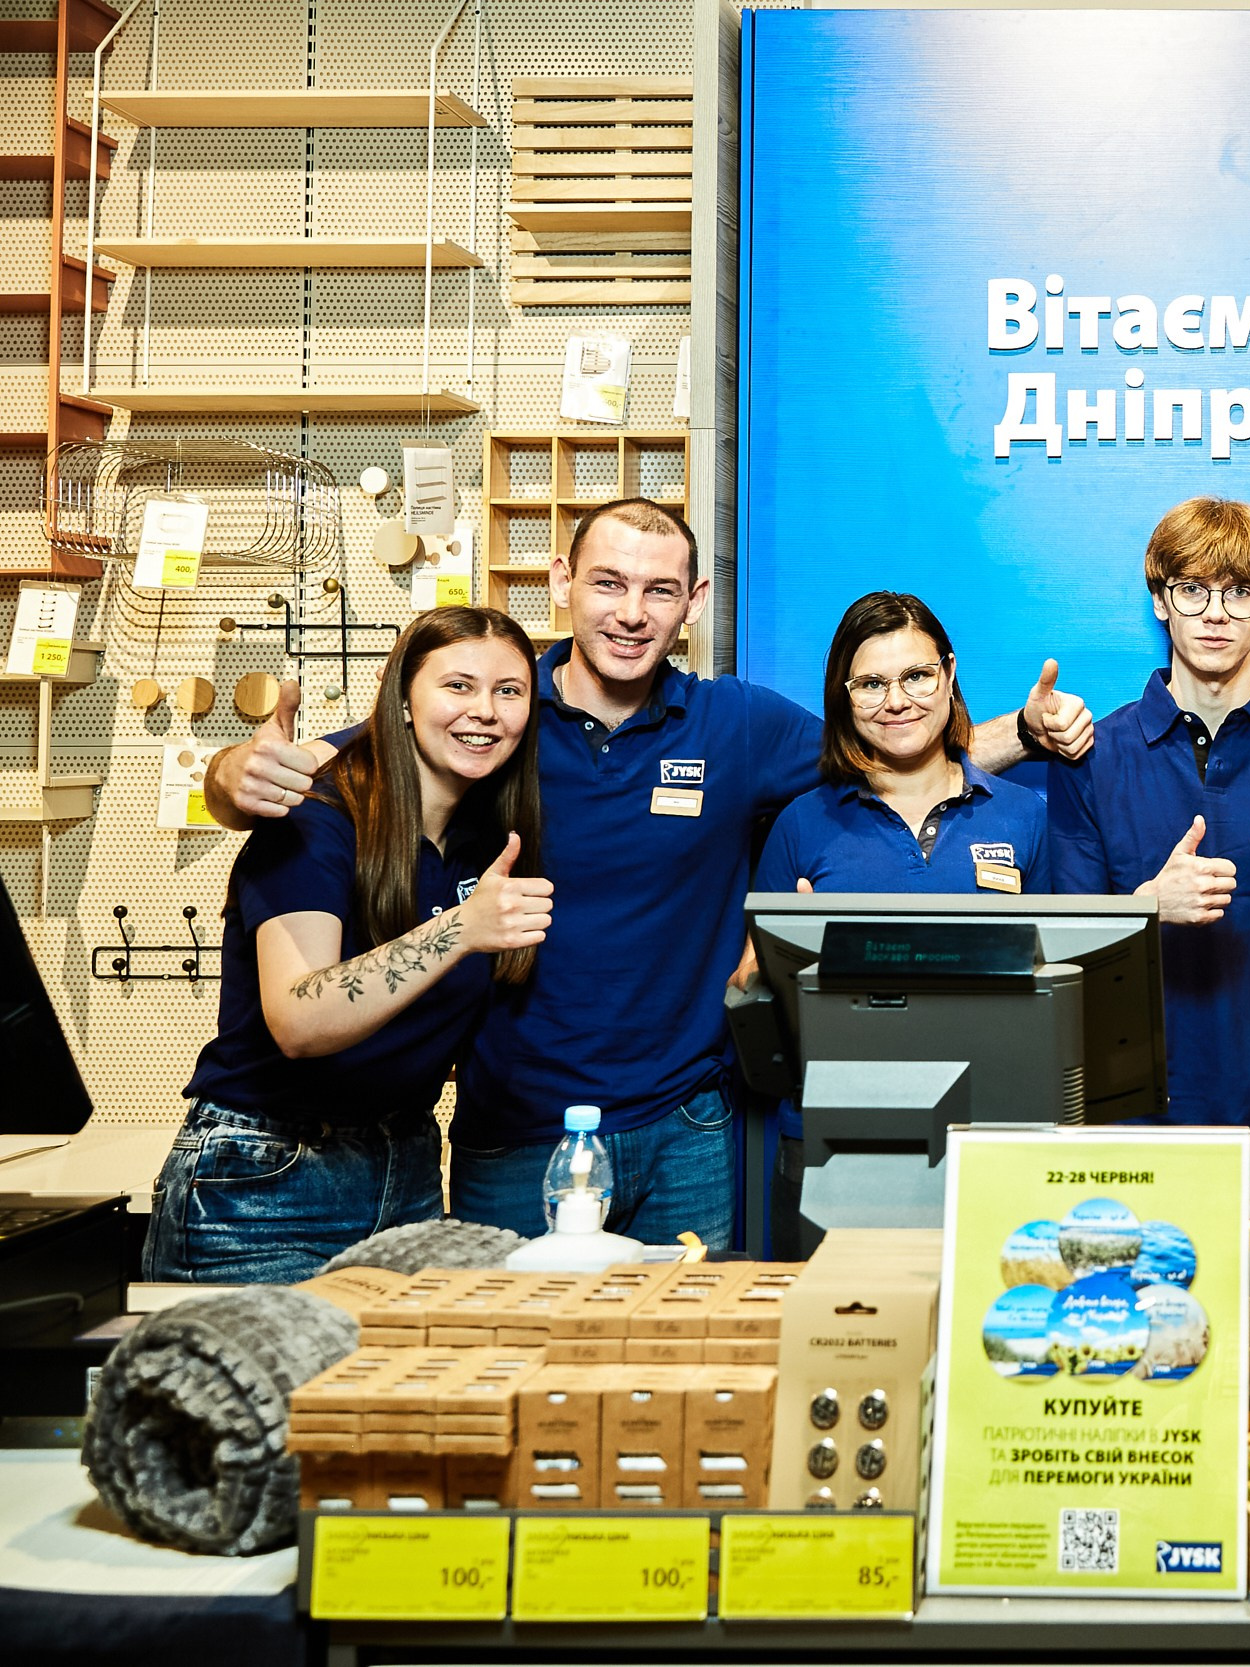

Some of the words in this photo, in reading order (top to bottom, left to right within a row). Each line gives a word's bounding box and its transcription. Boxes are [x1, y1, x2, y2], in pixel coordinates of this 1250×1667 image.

[448, 587, 469, 598] 650,-
[671, 765, 702, 778] JYSK
[984, 848, 1011, 859] JYSK
[1046, 1171, 1087, 1184] 22-28
[1090, 1170, 1155, 1184] ЧЕРВНЯ!
[848, 1337, 898, 1348] BATTERIES
[1044, 1397, 1143, 1417] КУПУЙТЕ
[983, 1426, 1077, 1443] ПАТРІОТИЧНІ
[1081, 1427, 1145, 1443] НАЛІПКИ
[1162, 1429, 1202, 1444] JYSK
[990, 1448, 1007, 1462] ТА
[1011, 1449, 1081, 1463] ЗРОБІТЬ
[1085, 1447, 1124, 1463] СВІЙ
[1127, 1450, 1195, 1464] ВНЕСОК
[989, 1469, 1020, 1485] ДЛЯ
[1023, 1470, 1115, 1485] ПЕРЕМОГИ
[1118, 1468, 1193, 1485] УКРАЇНИ
[1168, 1547, 1221, 1568] JYSK
[441, 1567, 494, 1589] 100,-
[641, 1567, 694, 1590] 100,-
[858, 1565, 899, 1588] 85,-
